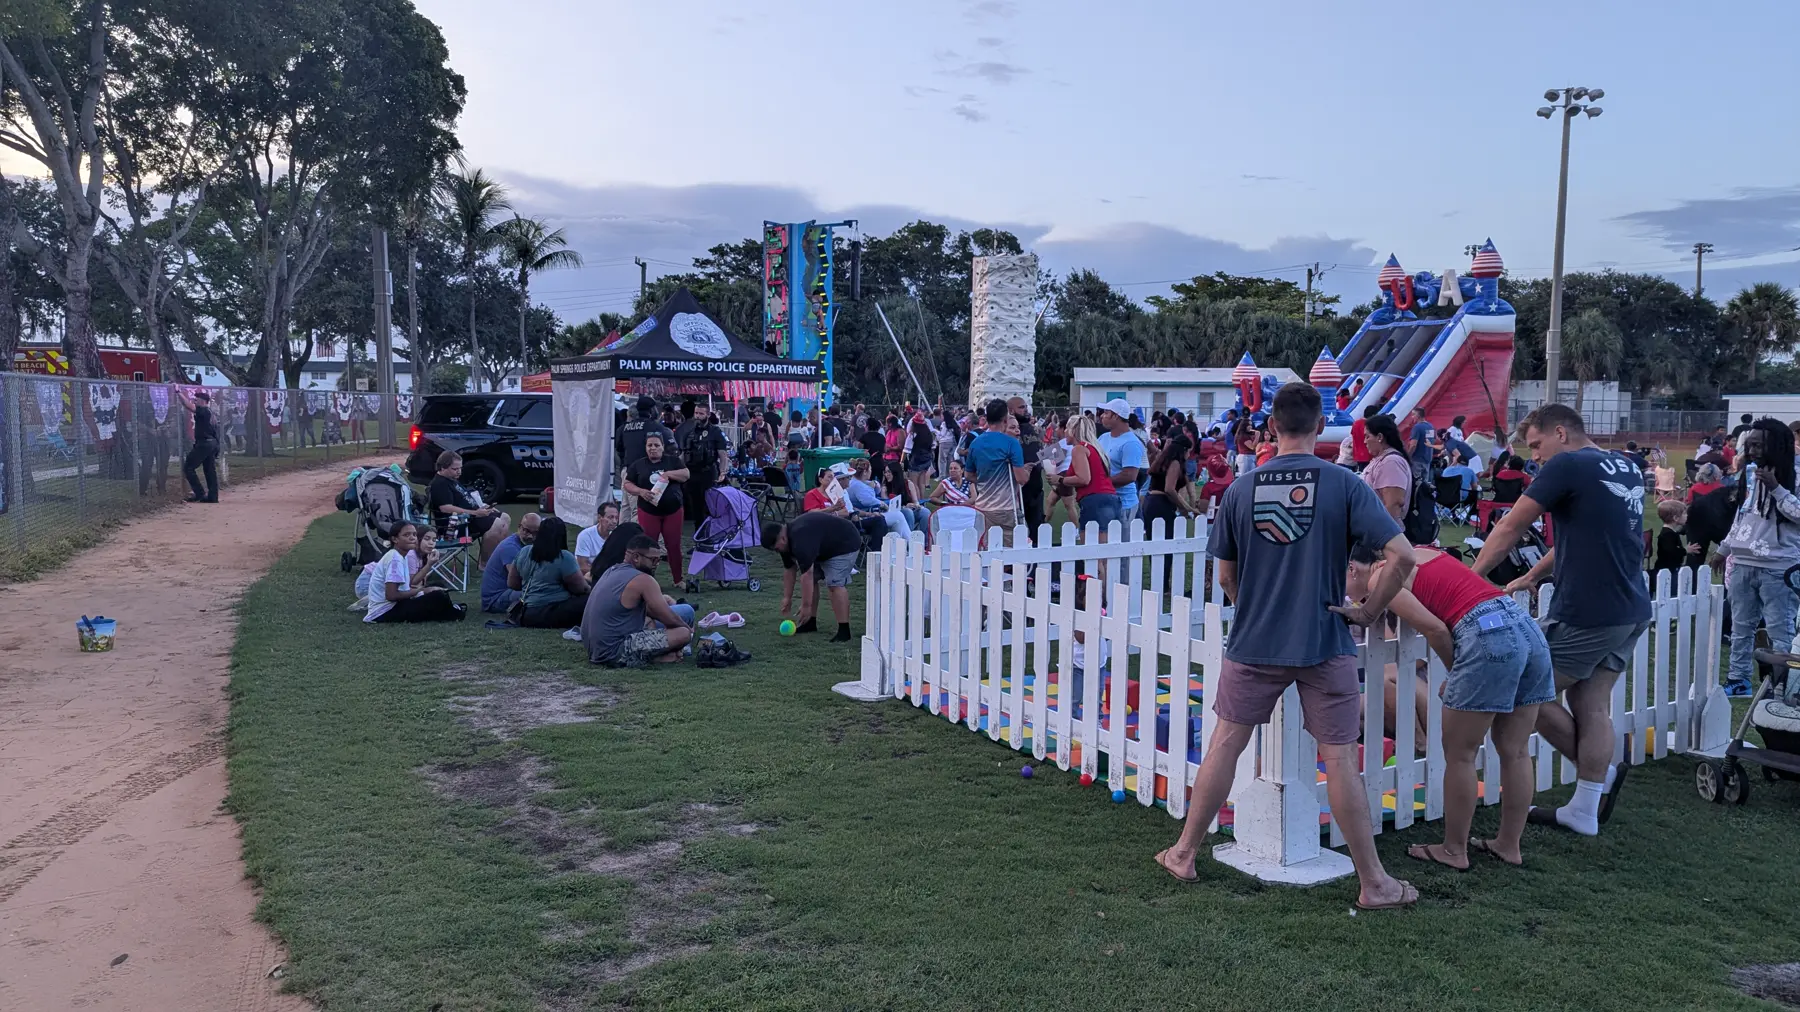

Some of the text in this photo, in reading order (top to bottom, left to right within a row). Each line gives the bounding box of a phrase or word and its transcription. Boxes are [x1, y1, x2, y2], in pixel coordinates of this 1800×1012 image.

[1391, 269, 1462, 311] USA
[551, 360, 611, 373] PALM SPRINGS POLICE DEPARTMENT
[620, 360, 816, 375] PALM SPRINGS POLICE DEPARTMENT
[624, 421, 644, 431] POLICE
[511, 445, 554, 460] PO
[1260, 471, 1313, 482] VISSLA
[1599, 459, 1643, 479] USA
